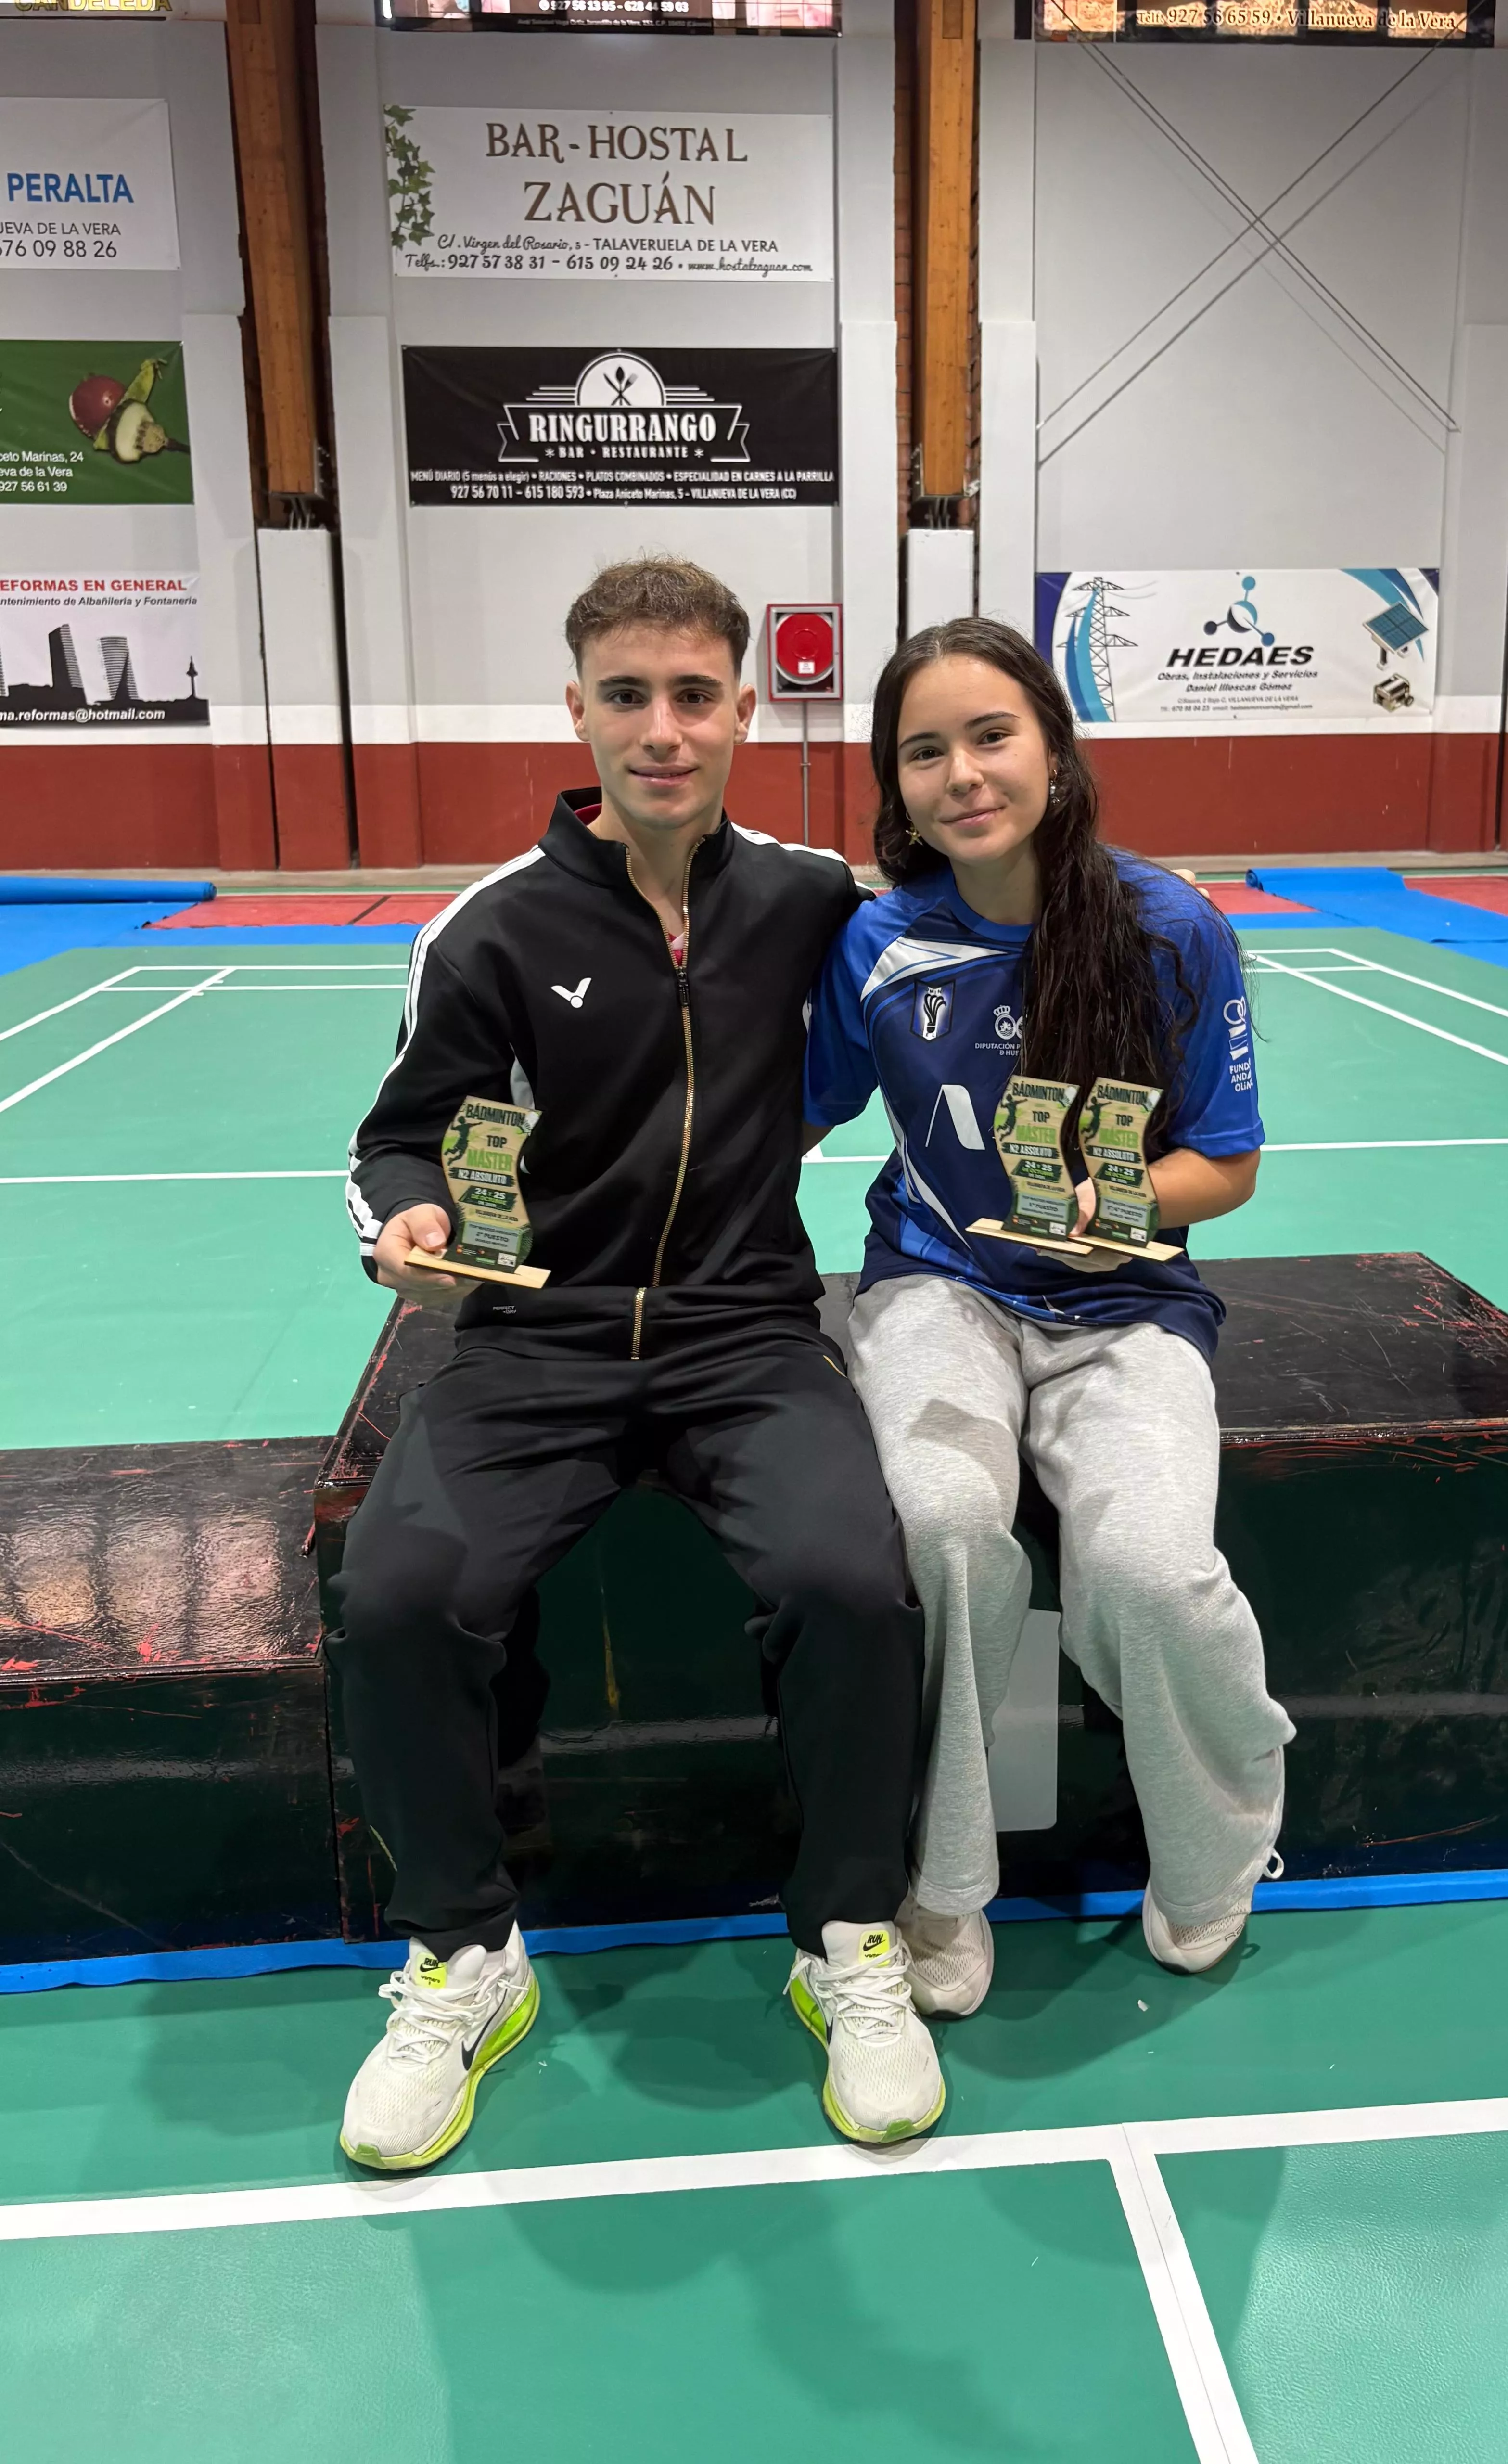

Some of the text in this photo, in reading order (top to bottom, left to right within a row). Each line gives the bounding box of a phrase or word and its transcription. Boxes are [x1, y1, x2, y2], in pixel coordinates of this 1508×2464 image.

[1168, 7, 1198, 23] 927
[1204, 9, 1222, 24] 56
[1227, 9, 1248, 25] 65
[1252, 10, 1271, 24] 59
[1286, 9, 1373, 28] Villanueva
[1378, 10, 1396, 27] de
[1399, 10, 1415, 28] la
[1419, 11, 1455, 29] Vera
[7, 173, 134, 203] PERALTA
[524, 171, 716, 225] ZAGUÁN
[38, 222, 57, 235] DE
[61, 223, 79, 235] LA
[82, 223, 121, 235] VERA
[0, 240, 117, 258] 76 09 88 26
[463, 235, 501, 255] Virgen
[502, 234, 522, 249] del
[593, 238, 692, 252] TALAVERUELA
[697, 240, 715, 251] DE
[720, 240, 737, 252] LA
[741, 240, 779, 253] VERA
[448, 254, 478, 270] 927
[482, 255, 501, 269] 57
[505, 255, 523, 270] 38
[529, 255, 545, 270] 31
[566, 255, 594, 270] 615
[600, 256, 620, 271] 09
[626, 257, 647, 270] 24
[652, 256, 673, 271] 26
[528, 413, 716, 443] RINGURRANGO
[70, 451, 84, 462] 24
[558, 446, 689, 458] BAR RESTAURANTE
[19, 466, 33, 477] de
[35, 466, 46, 477] la
[47, 466, 73, 477] Vera
[731, 471, 742, 482] EN
[777, 471, 783, 482] A
[784, 471, 794, 482] LA
[37, 481, 50, 492] 61
[53, 481, 67, 492] 39
[450, 485, 470, 499] 927
[471, 485, 485, 499] 56
[486, 485, 499, 499] 70
[501, 485, 513, 499] 11
[524, 485, 543, 499] 615
[546, 485, 563, 499] 180
[565, 485, 585, 499] 593
[677, 488, 683, 499] 5
[737, 488, 748, 499] DE
[749, 488, 759, 499] LA
[760, 488, 780, 499] VERA
[0, 580, 187, 591] EFORMAS EN GENERAL
[64, 597, 76, 605] de
[135, 598, 141, 607] y
[1166, 646, 1314, 667] HEDAES
[1157, 670, 1318, 681] Obras, Instalaciones y Servicios
[1186, 683, 1217, 692] Daniel
[1012, 1081, 1065, 1102] BÁDMINTON
[1097, 1084, 1149, 1105] BÁDMINTON
[466, 1103, 525, 1127] BÁDMINTON
[1032, 1110, 1050, 1123] TOP
[1115, 1114, 1133, 1126] TOP
[487, 1135, 507, 1148] TOP
[1041, 1163, 1053, 1172] 25
[493, 1191, 506, 1200] 25
[867, 1934, 883, 1944] RUN
[424, 1957, 439, 1967] RUN
